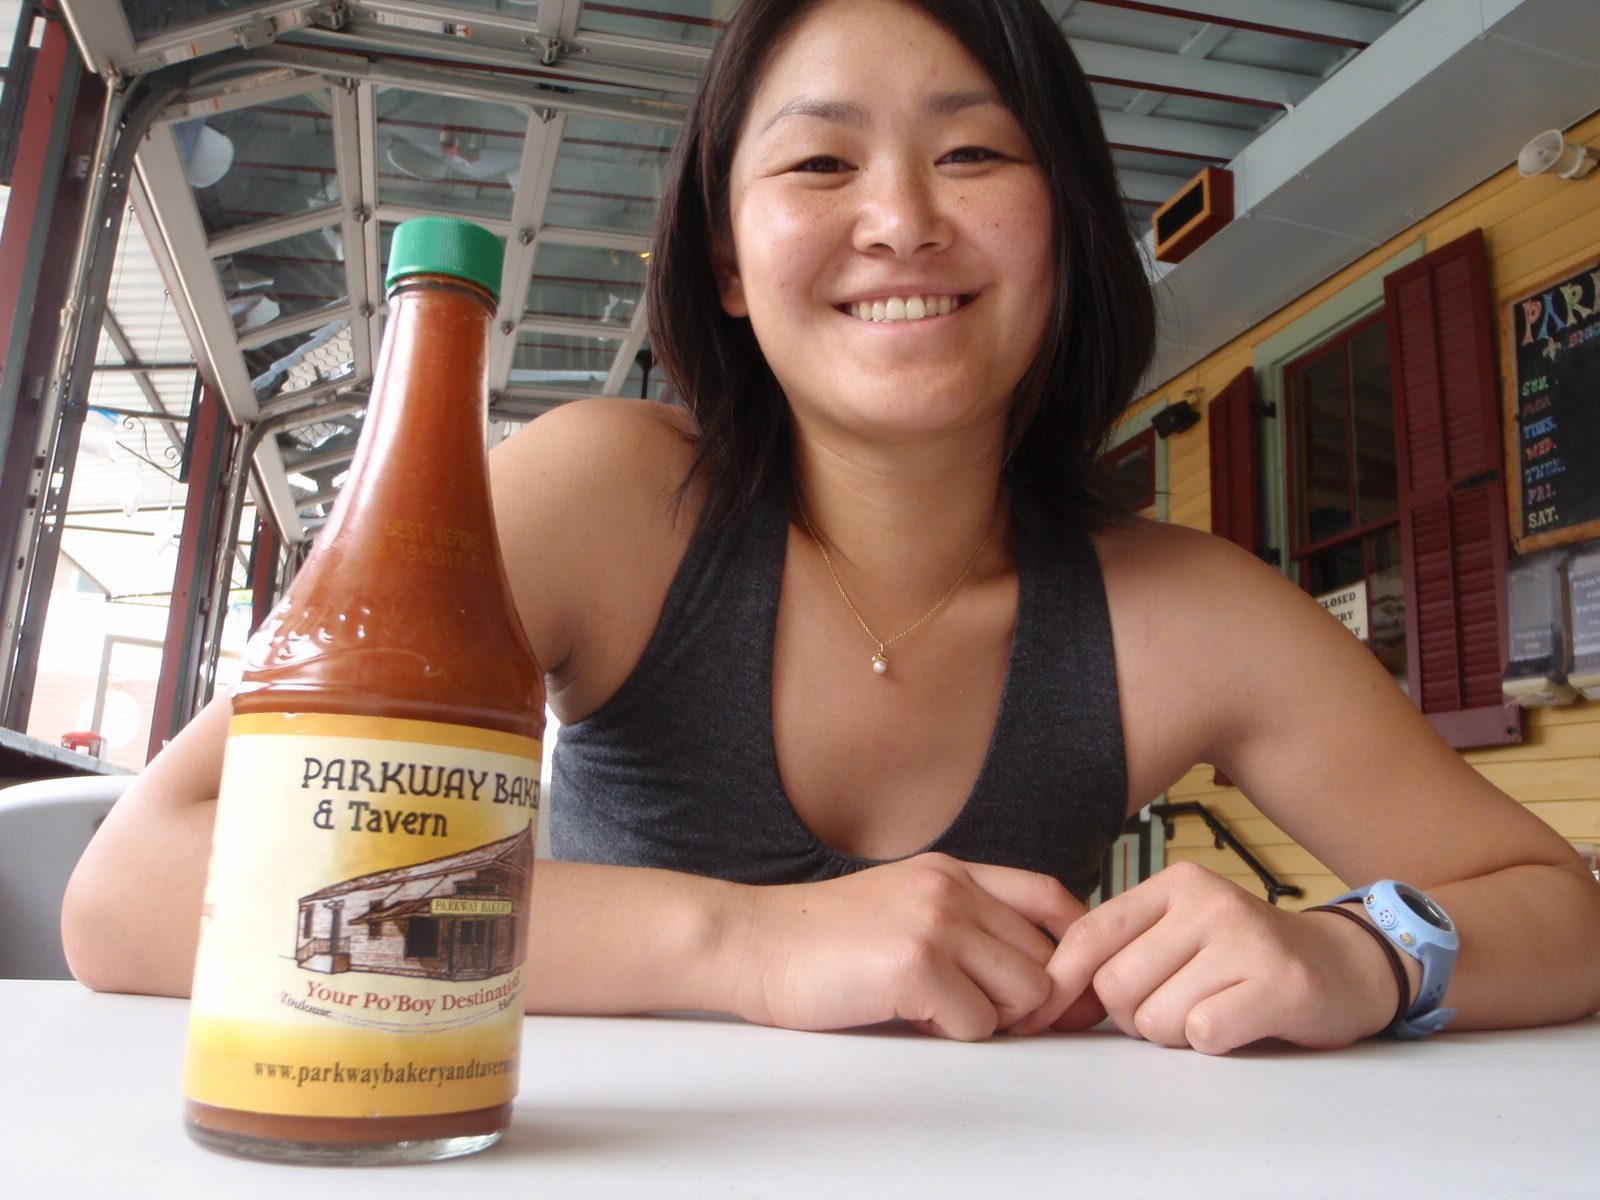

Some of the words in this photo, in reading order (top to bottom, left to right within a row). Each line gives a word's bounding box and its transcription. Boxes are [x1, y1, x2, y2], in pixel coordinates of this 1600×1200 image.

[1528, 506, 1559, 529] SAT.
[301, 757, 488, 801] PARKWAY
[313, 799, 335, 830] &
[348, 800, 448, 837] Tavern
[435, 899, 478, 912] PARKWAY
[305, 980, 359, 1006] Your
[363, 991, 436, 1017] Po'Boy
